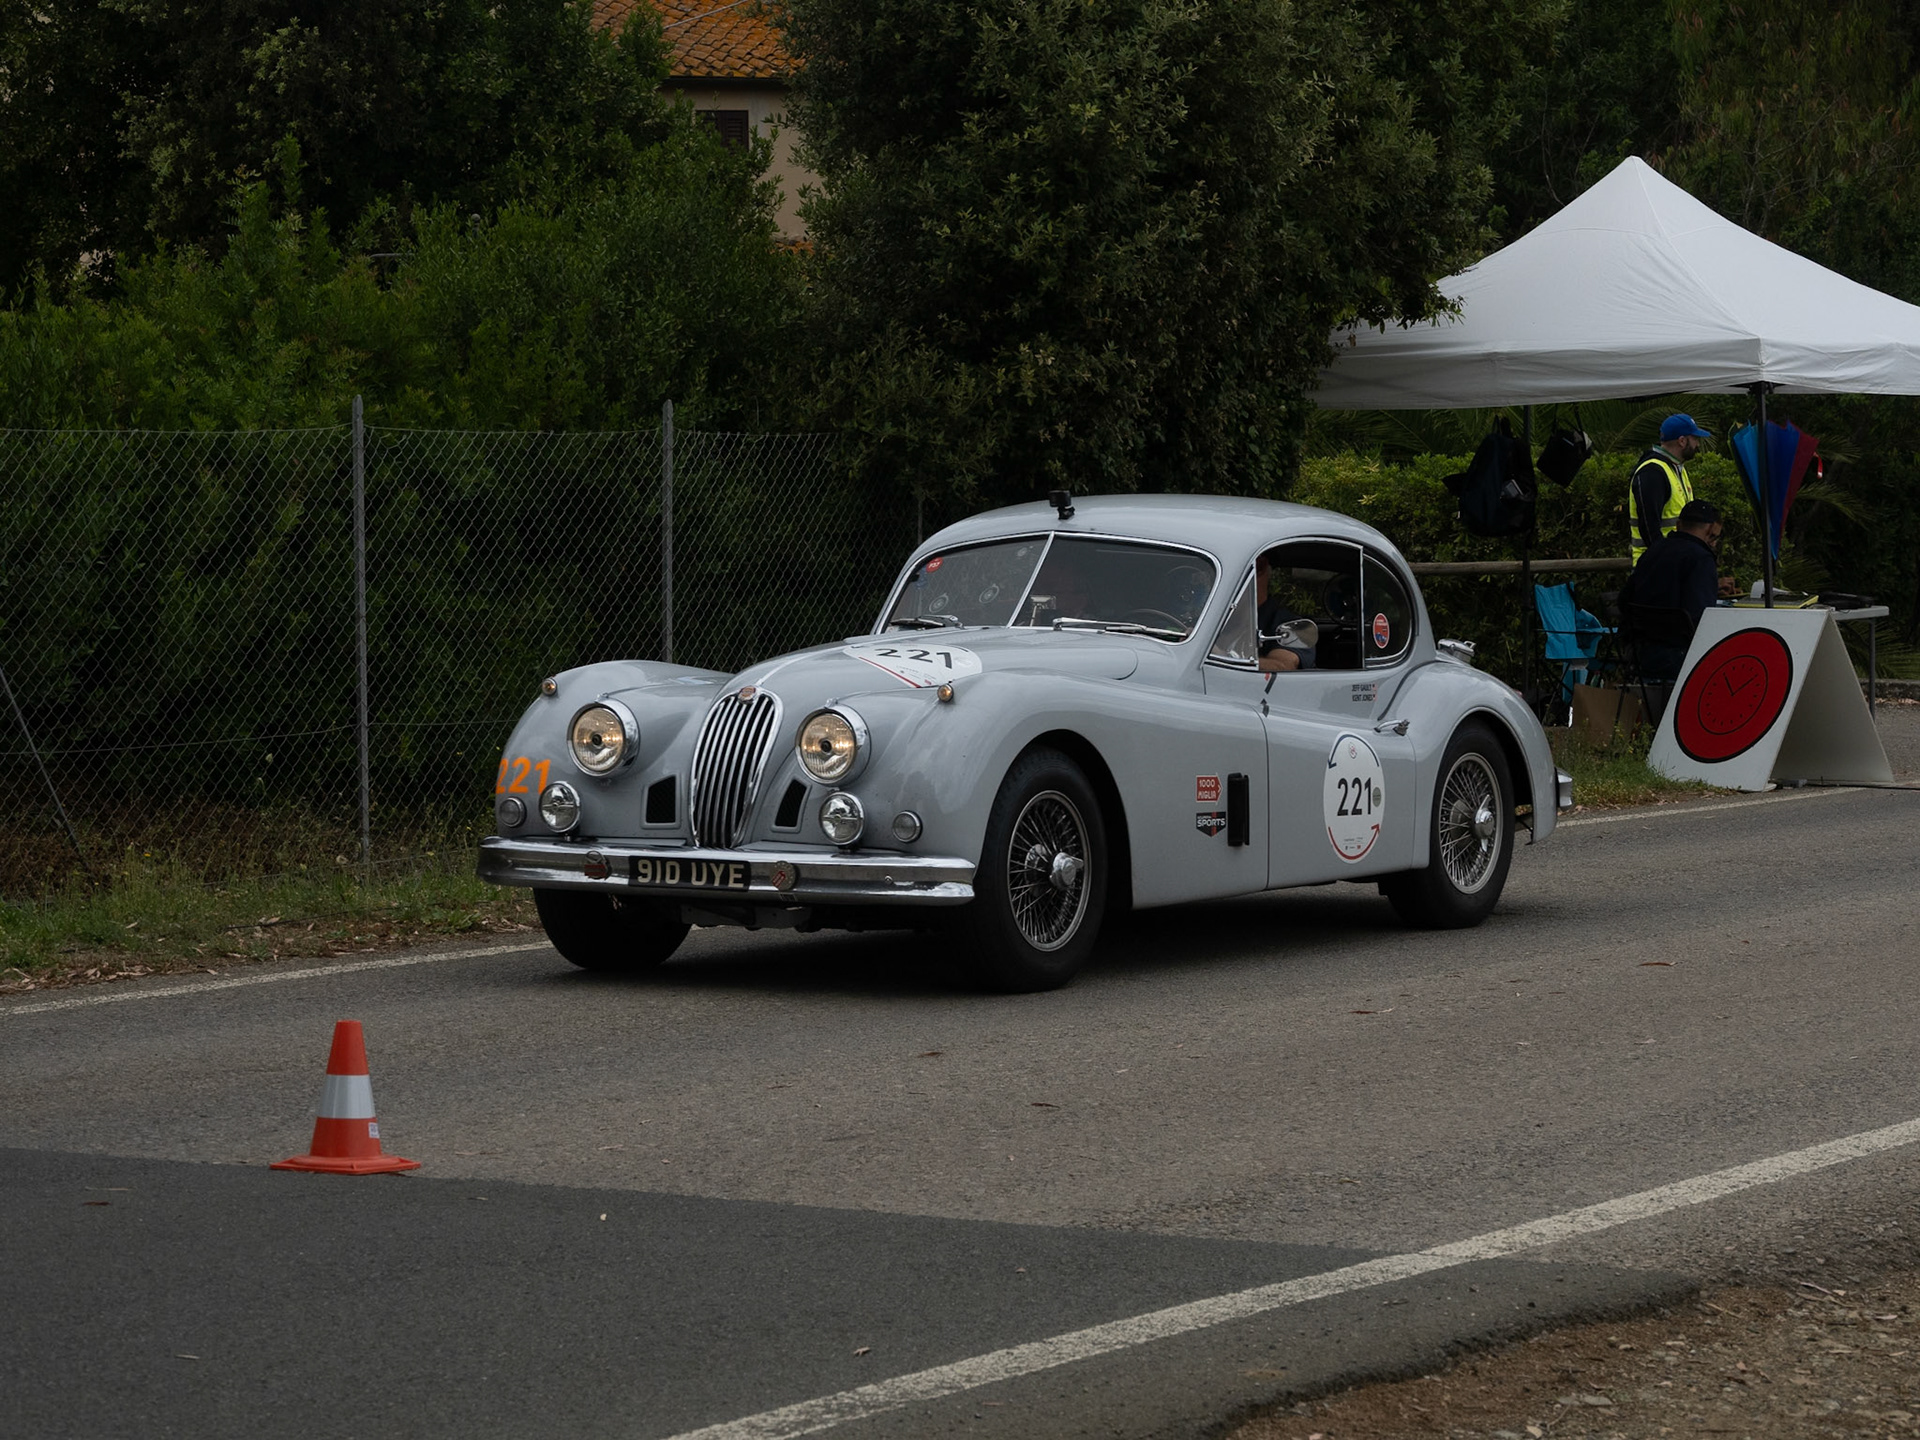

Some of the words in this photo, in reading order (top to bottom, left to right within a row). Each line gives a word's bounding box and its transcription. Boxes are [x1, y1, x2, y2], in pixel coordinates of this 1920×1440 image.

[875, 648, 952, 669] 221
[1199, 779, 1215, 788] 1000
[1198, 790, 1217, 799] MIGLIA
[1337, 777, 1371, 816] 221
[1197, 818, 1226, 827] SPORTS
[637, 859, 680, 884] 910
[691, 862, 745, 888] UYE
